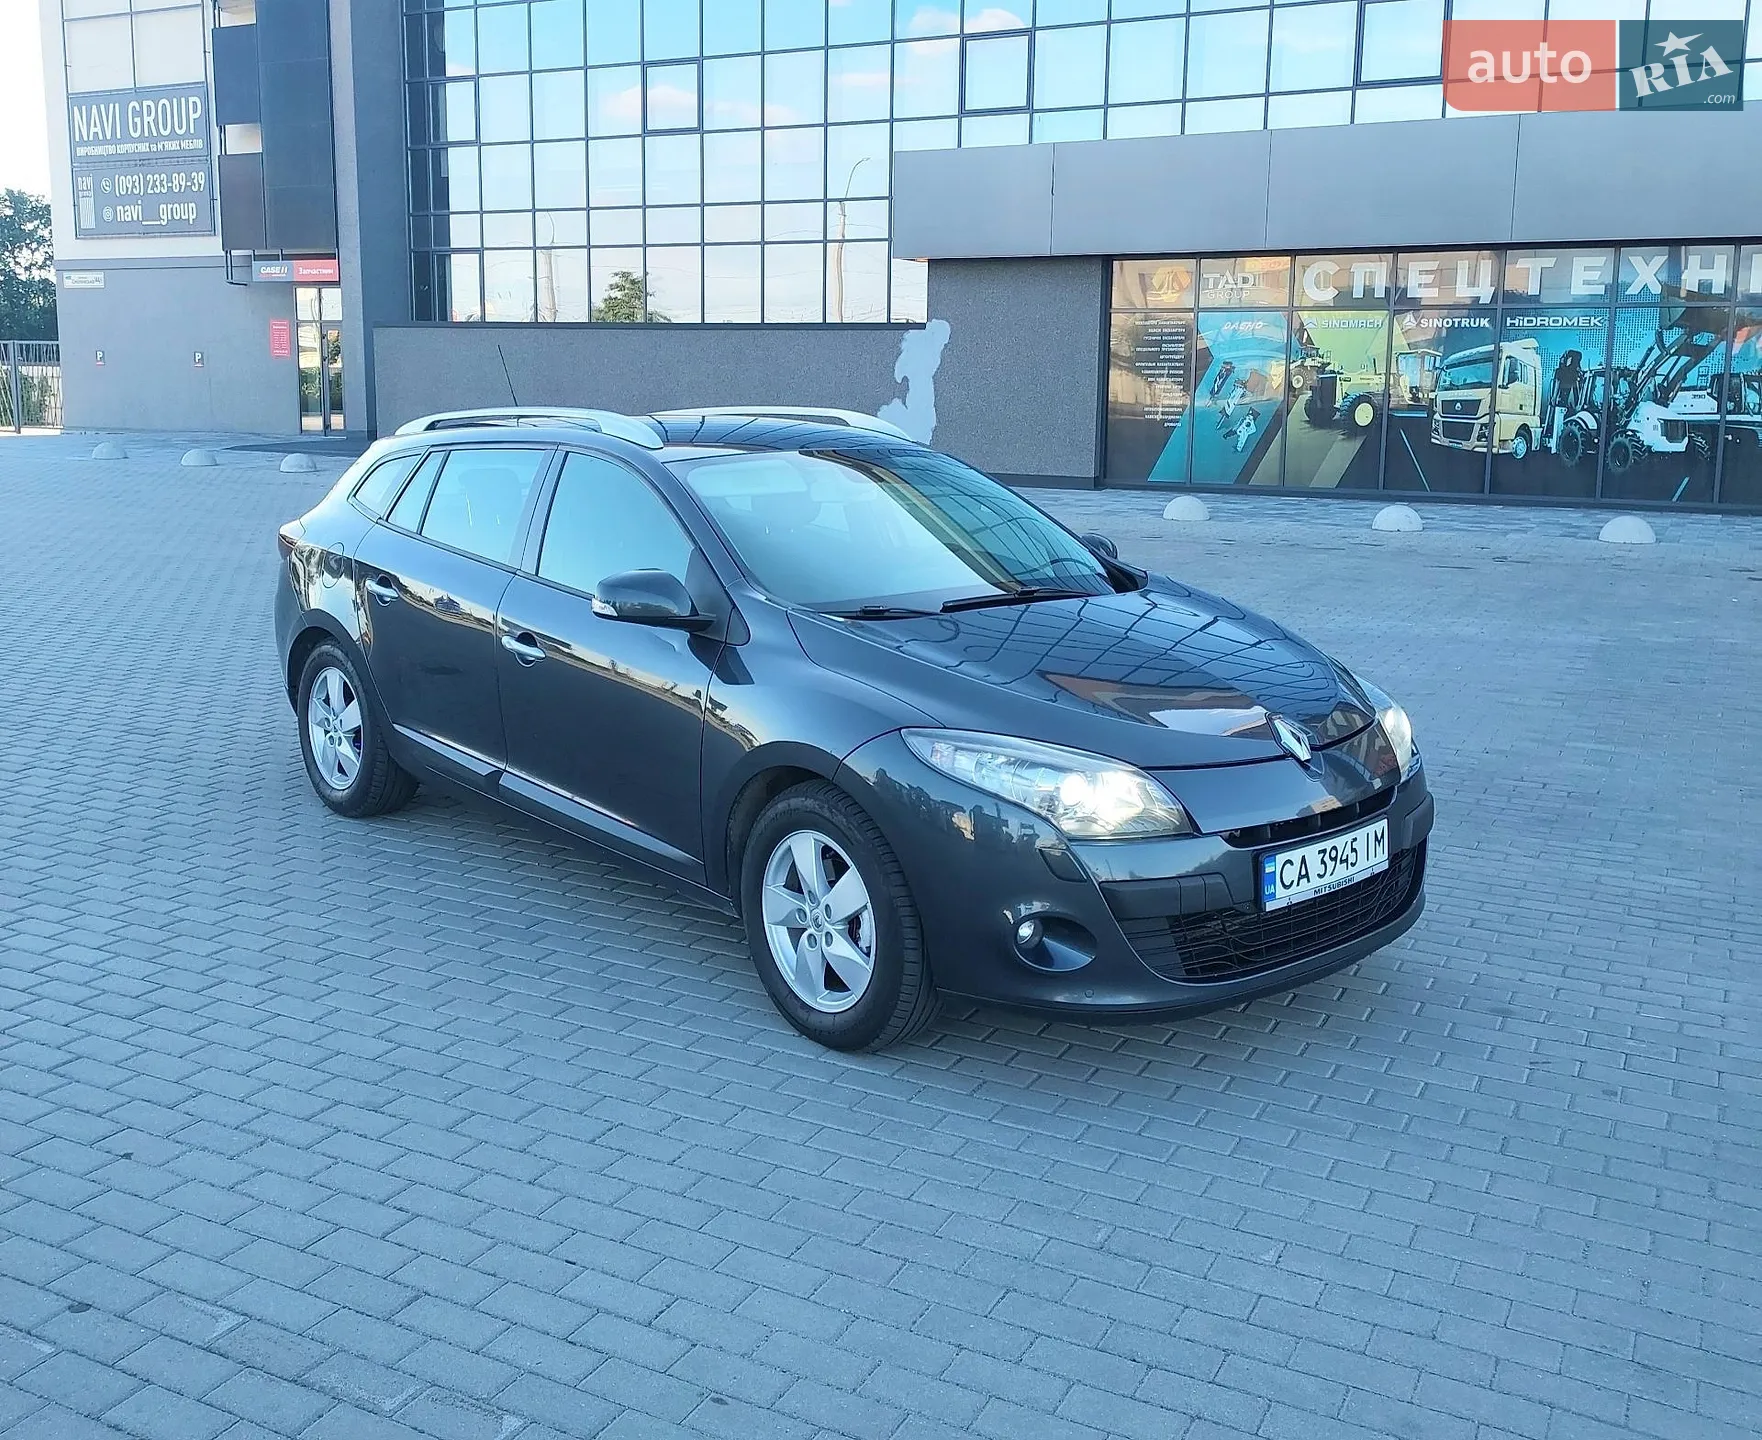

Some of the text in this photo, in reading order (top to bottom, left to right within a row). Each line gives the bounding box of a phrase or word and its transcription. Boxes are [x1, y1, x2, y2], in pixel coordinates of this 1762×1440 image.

[74, 96, 202, 142] NAVI GROUP
[114, 171, 206, 197] (093) 233-89-39
[260, 266, 280, 274] CASE
[1202, 270, 1255, 289] TAD
[1206, 290, 1250, 299] GROUP
[1321, 319, 1383, 329] SINOMACH
[1420, 317, 1490, 328] SINOTRUK
[1279, 826, 1386, 891] CA 3945 IM
[1264, 884, 1275, 896] UA
[1313, 876, 1355, 897] MITSUBISHI
